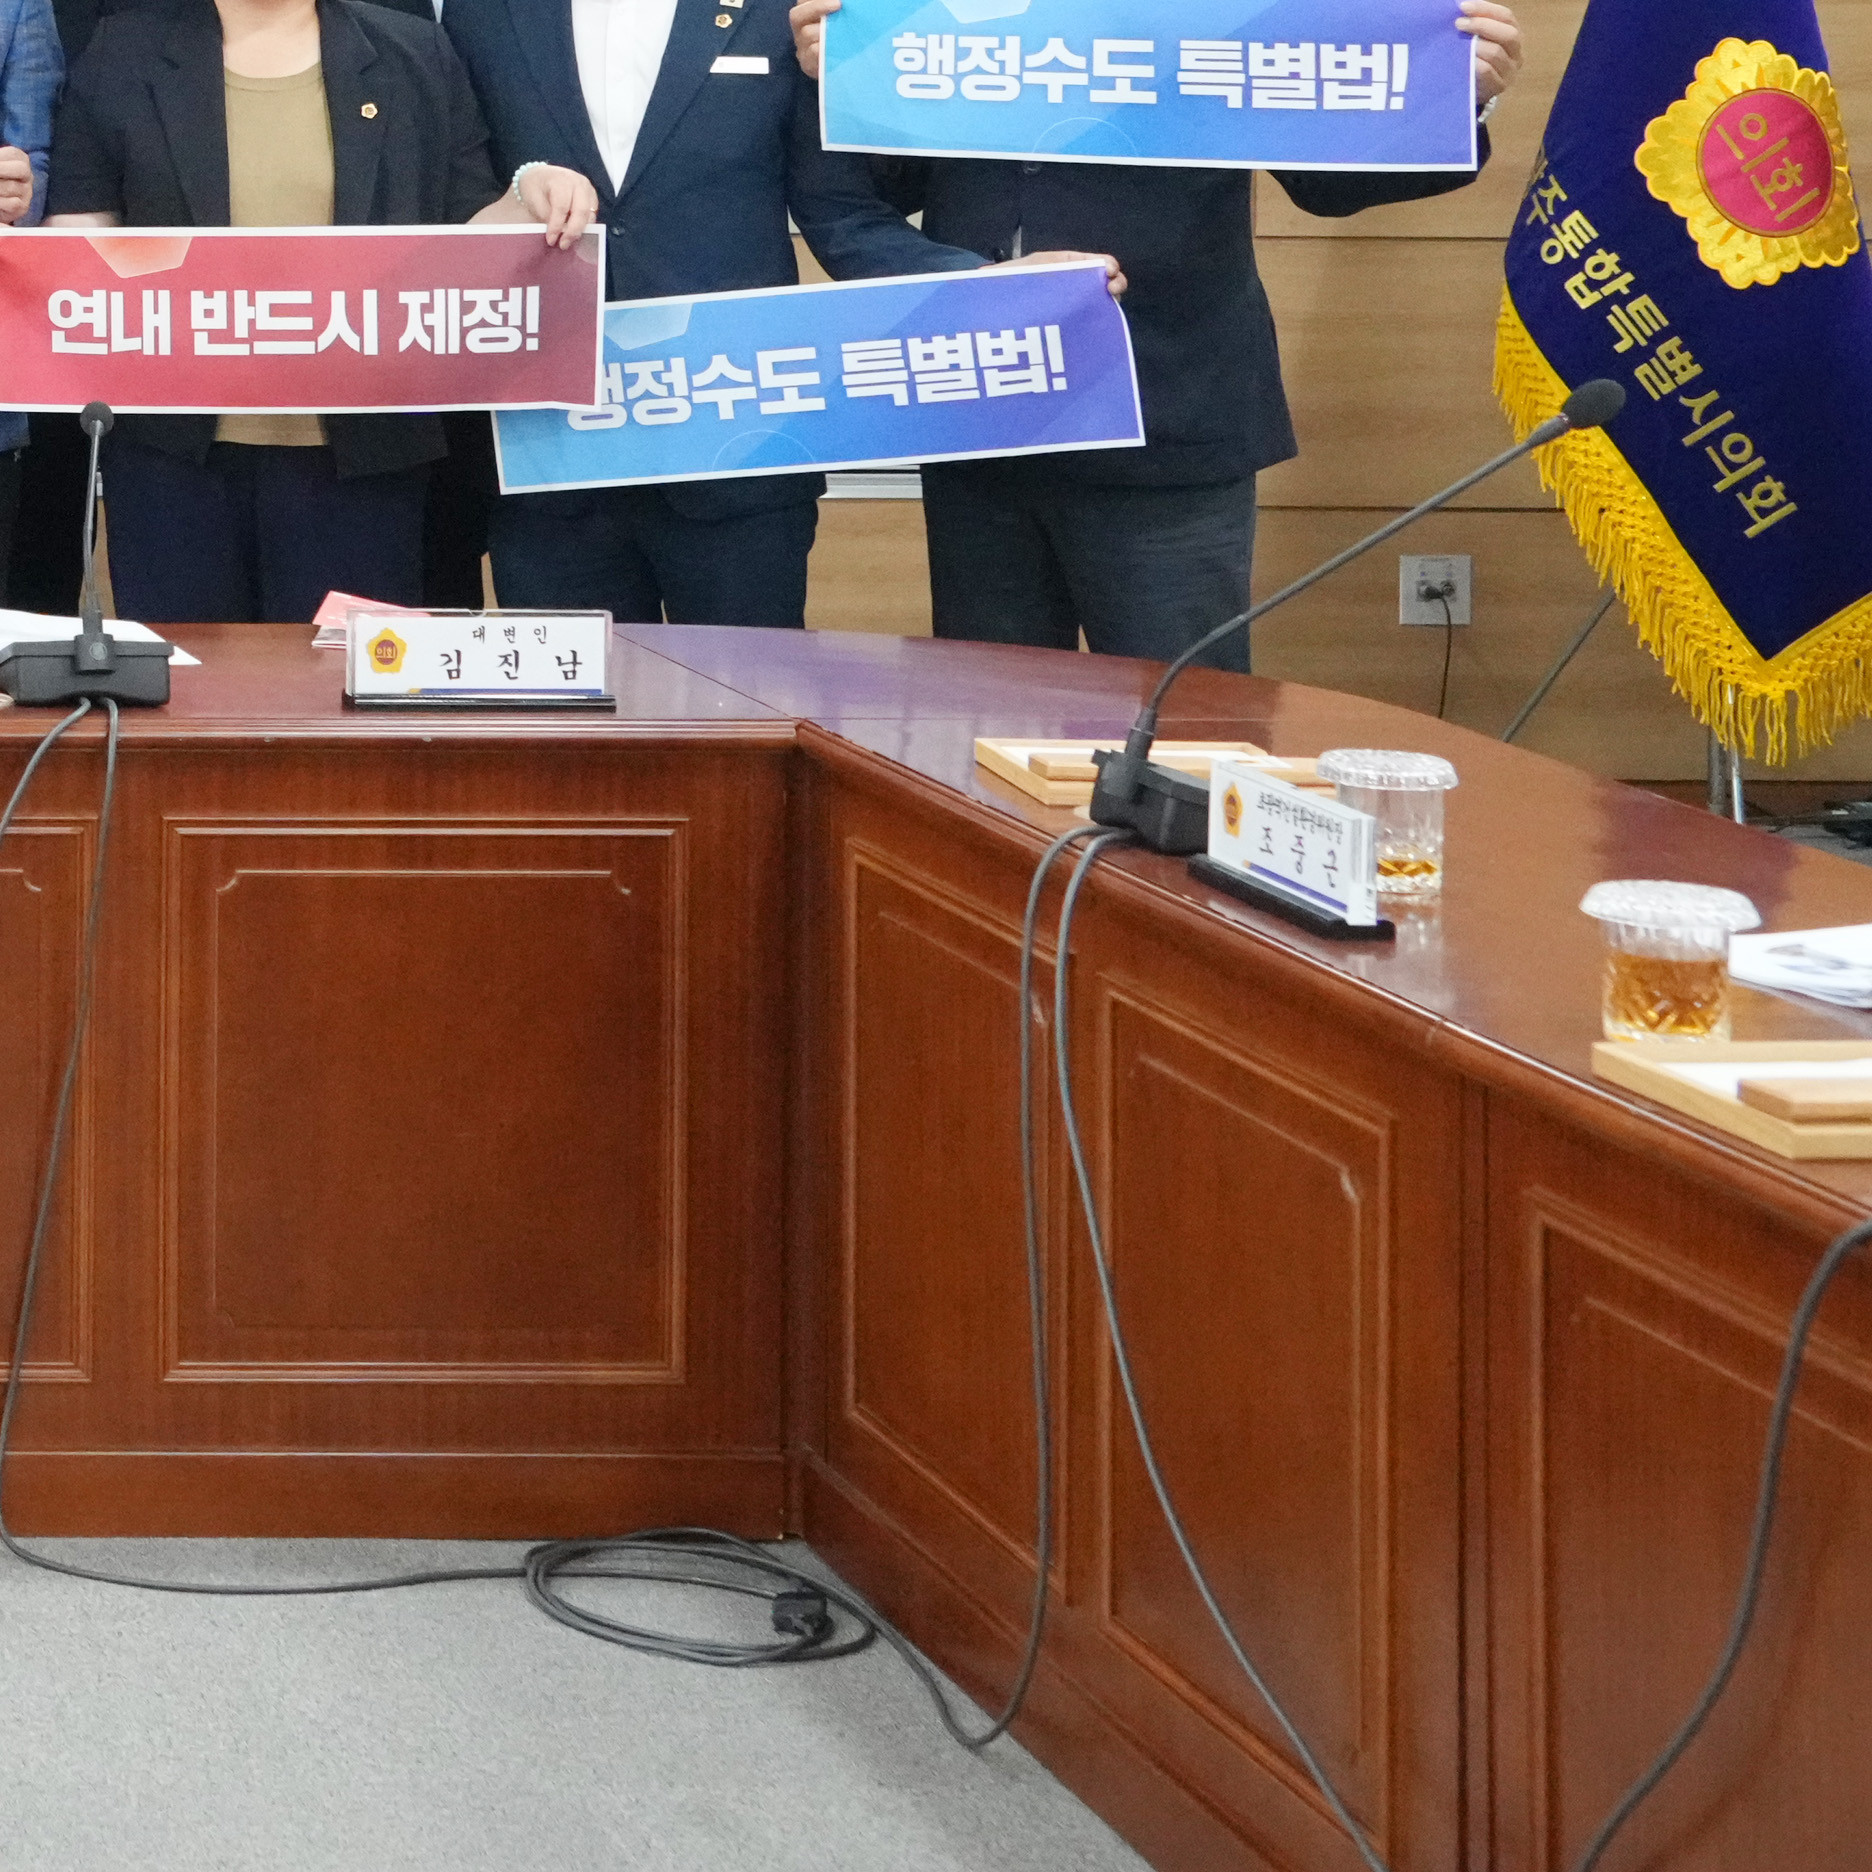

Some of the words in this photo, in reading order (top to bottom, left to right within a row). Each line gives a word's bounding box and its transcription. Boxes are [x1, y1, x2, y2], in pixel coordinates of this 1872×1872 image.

[893, 32, 1156, 103] 행정수도
[1177, 40, 1408, 110] 특별법!
[1716, 113, 1821, 223] 의회
[48, 290, 170, 355] 연내
[191, 290, 378, 355] 반드시
[399, 286, 539, 354] 제정!
[1528, 156, 1798, 539] 주통합특별시의회
[841, 325, 1067, 405] 특별법!
[441, 650, 582, 680] 김진남
[473, 626, 546, 644] 대변인
